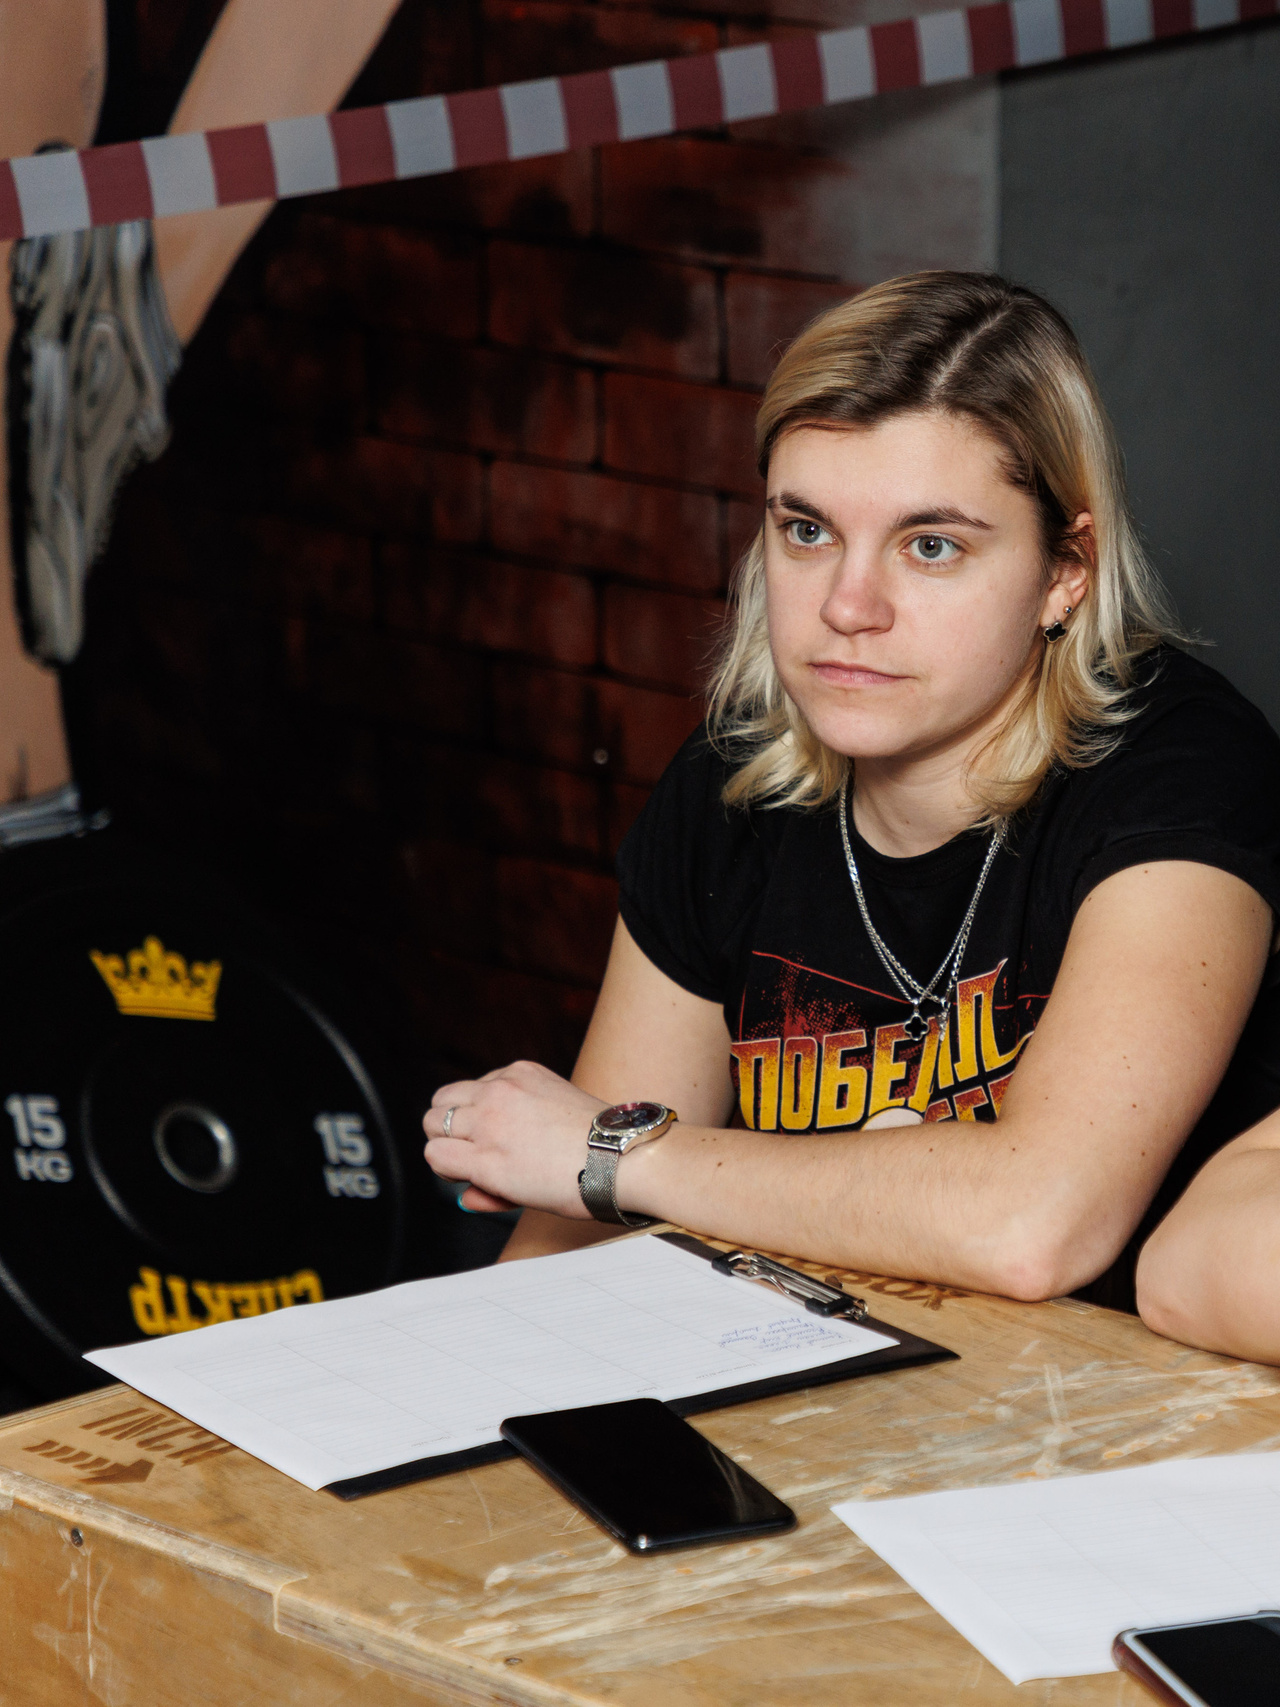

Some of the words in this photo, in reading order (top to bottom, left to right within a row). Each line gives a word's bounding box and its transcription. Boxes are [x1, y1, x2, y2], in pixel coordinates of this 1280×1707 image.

[4, 1094, 67, 1150] 15
[313, 1112, 374, 1168] 15
[14, 1149, 73, 1183] KG
[322, 1167, 381, 1200] KG
